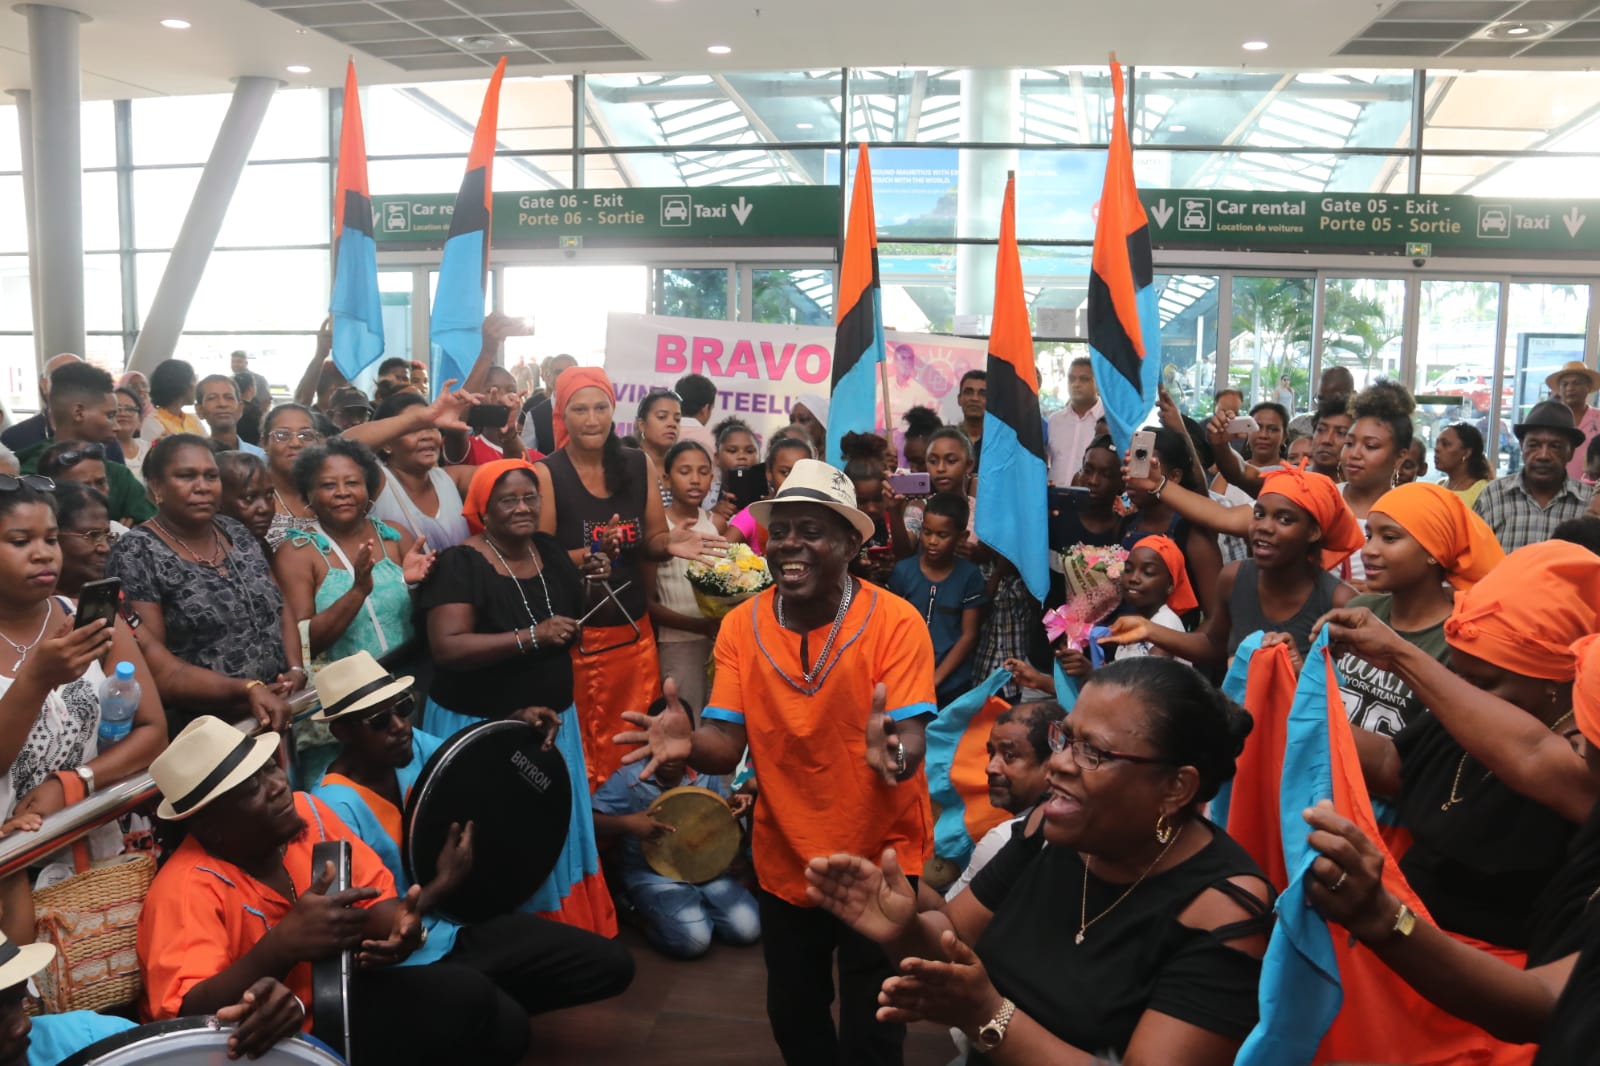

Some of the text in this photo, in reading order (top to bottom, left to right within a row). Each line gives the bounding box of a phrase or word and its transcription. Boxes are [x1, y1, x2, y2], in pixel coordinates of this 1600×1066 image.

[519, 195, 555, 209] Gate
[560, 194, 578, 208] 06
[593, 193, 624, 208] Exit
[1216, 199, 1306, 216] Car rental
[1321, 198, 1362, 213] Gate
[1367, 199, 1388, 213] 05
[1406, 200, 1440, 215] Exit
[412, 203, 436, 216] Car
[694, 203, 726, 219] Taxi
[519, 212, 559, 226] Porte
[564, 211, 582, 225] 06
[598, 210, 645, 225] Sortie
[1320, 216, 1366, 231] Porte
[1371, 217, 1392, 232] 05
[1410, 218, 1461, 233] Sortie
[1514, 215, 1550, 231] Taxi
[1216, 223, 1304, 233] Location de voitures
[655, 334, 832, 384] BRAVO
[1370, 687, 1407, 708] ATLANTA
[511, 750, 552, 790] BRYRON
